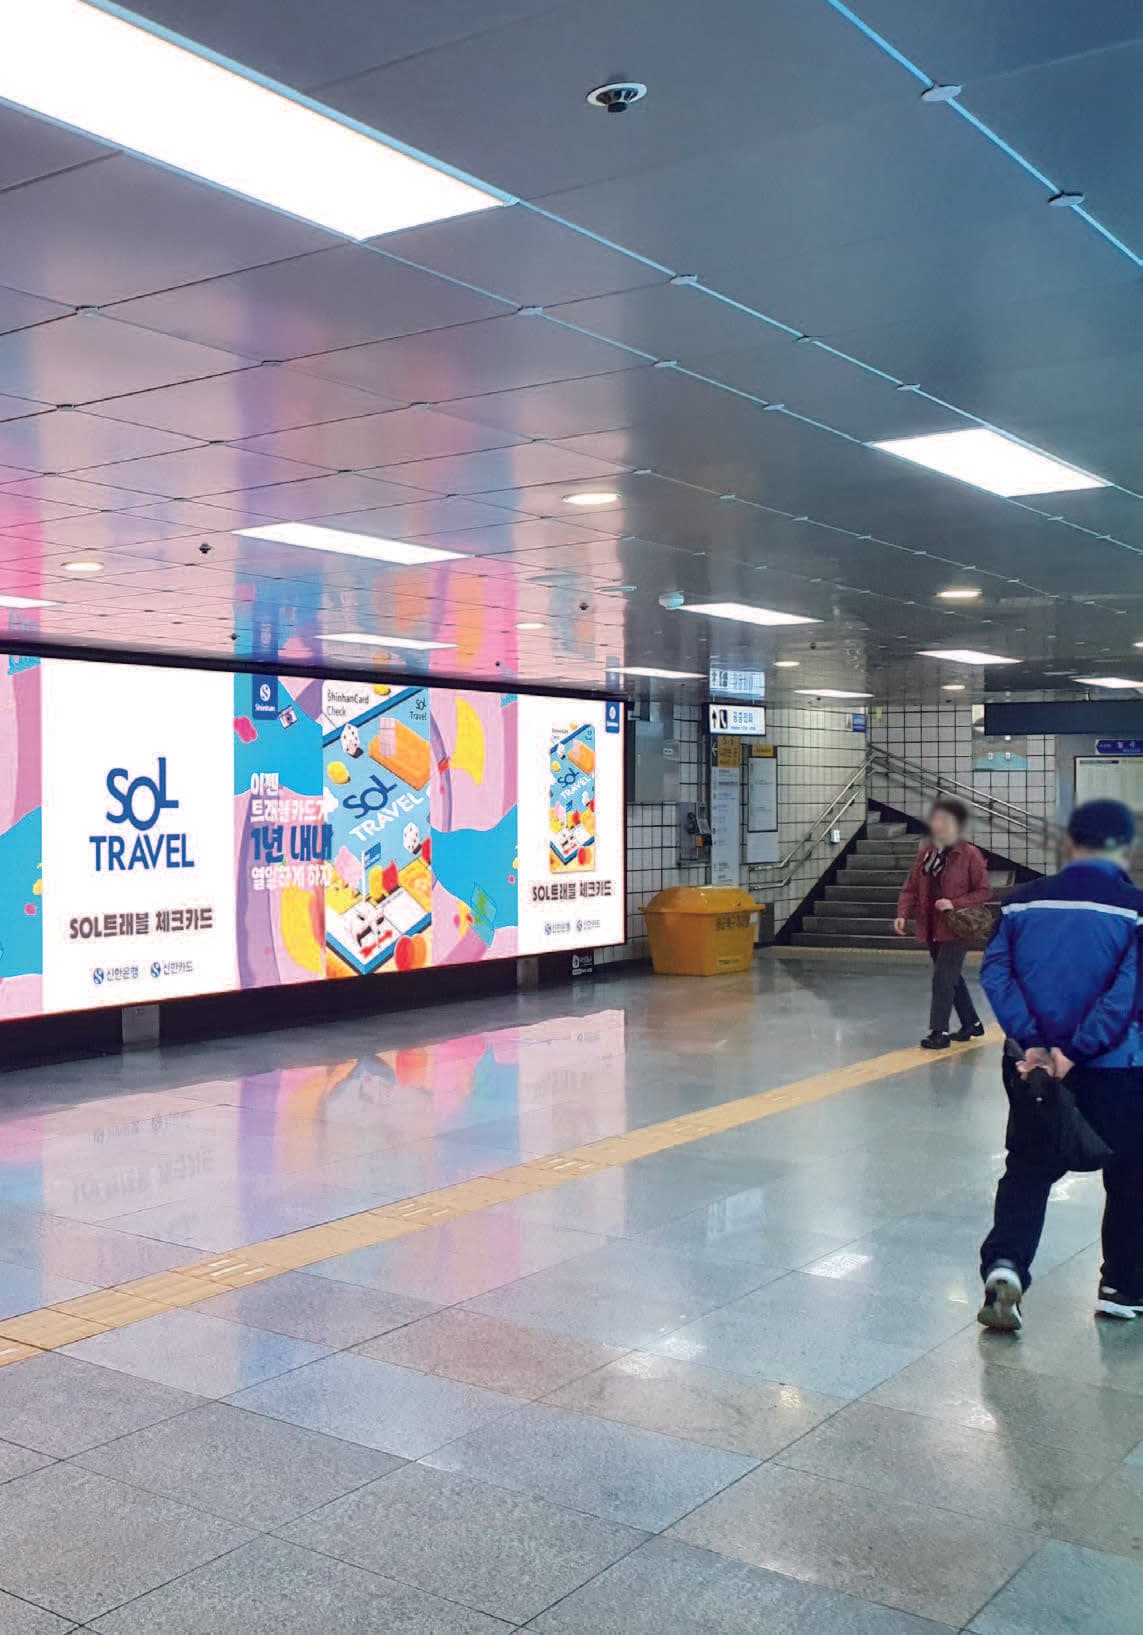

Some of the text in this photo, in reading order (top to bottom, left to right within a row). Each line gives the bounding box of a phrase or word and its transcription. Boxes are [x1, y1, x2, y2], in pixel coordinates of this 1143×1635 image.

[327, 705, 346, 717] Check
[348, 790, 425, 842] TRAVEL
[89, 833, 195, 871] TRAVEL
[250, 824, 285, 864] 1년
[290, 822, 333, 862] 내내
[69, 907, 213, 939] SOL트래블 체크카드
